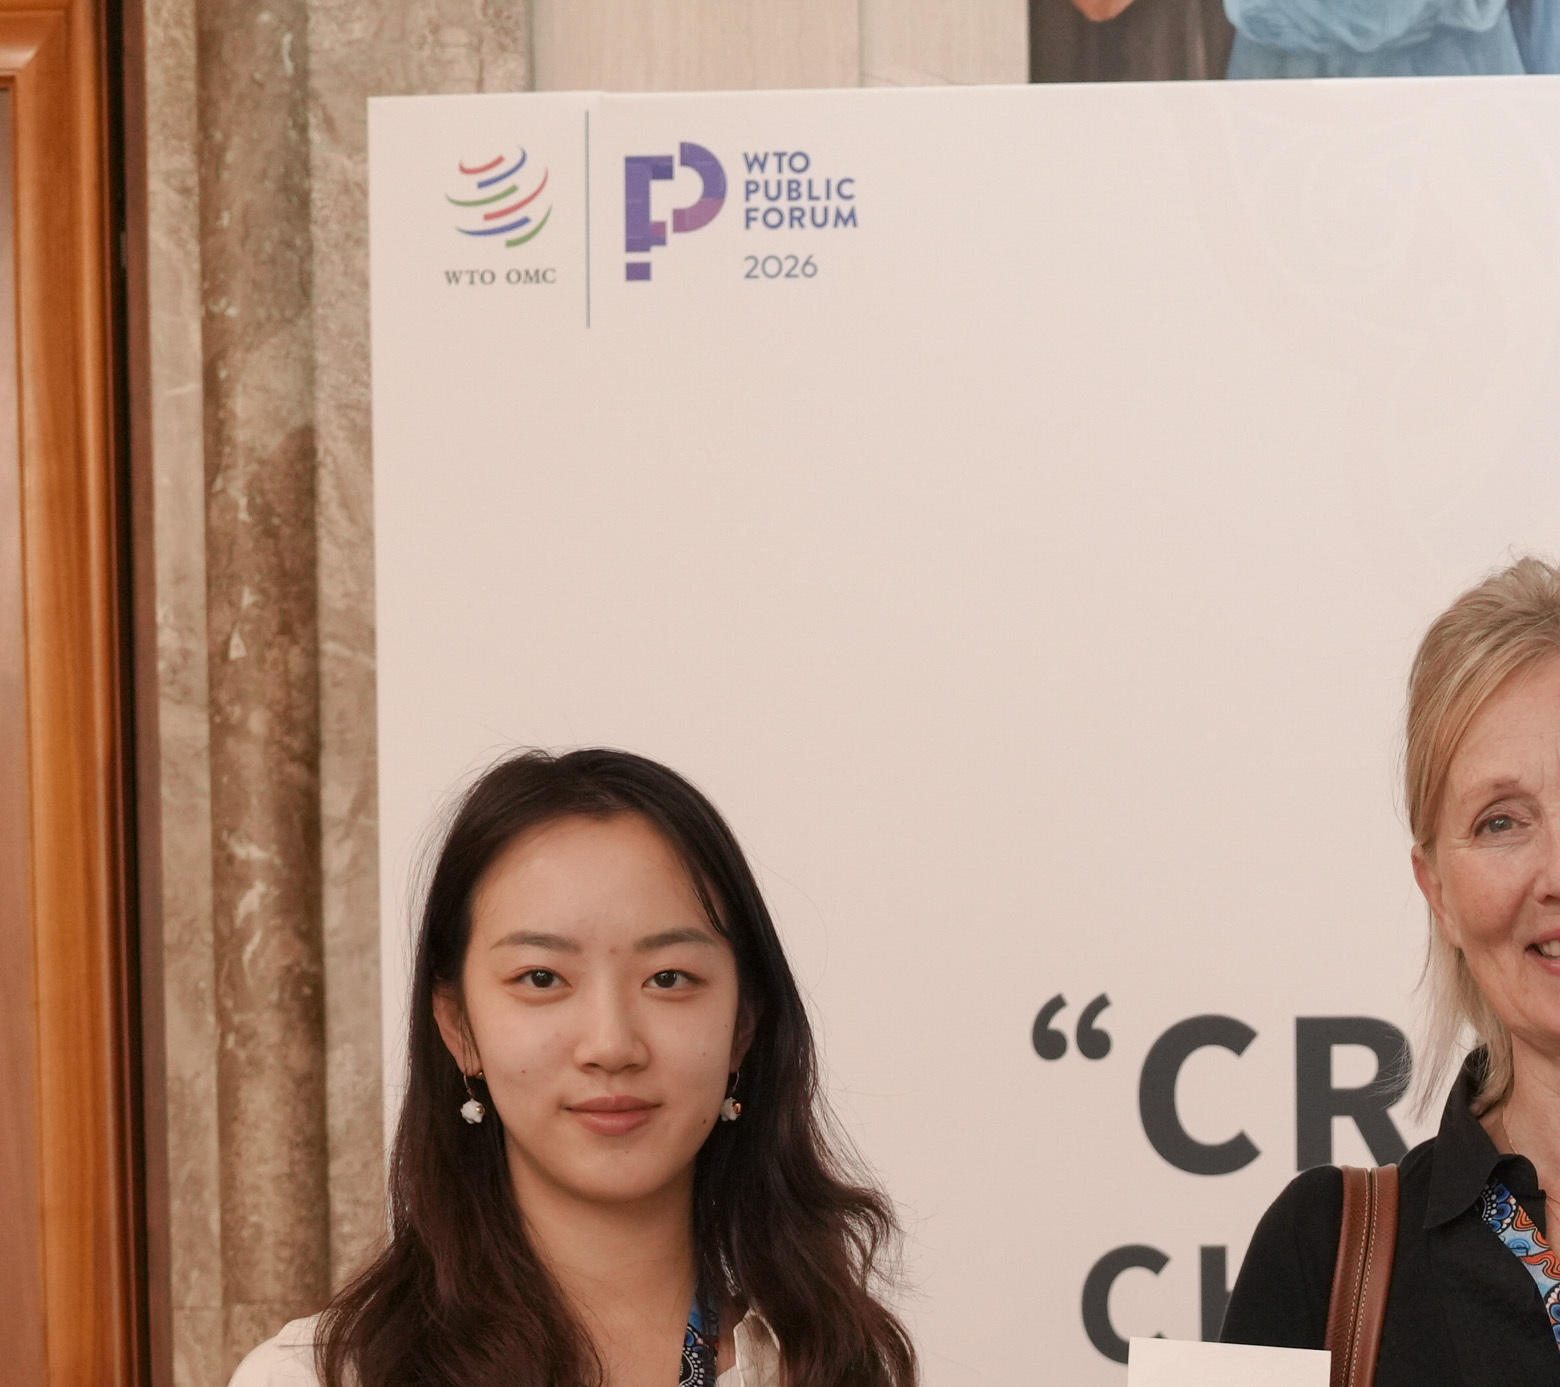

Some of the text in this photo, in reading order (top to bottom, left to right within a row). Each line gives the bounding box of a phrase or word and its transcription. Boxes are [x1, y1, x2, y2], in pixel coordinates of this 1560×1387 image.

[743, 151, 810, 174] WTO
[744, 178, 855, 202] PUBLIC
[744, 206, 858, 230] FORUM
[444, 268, 556, 286] WTO OMC
[743, 254, 818, 279] 2026
